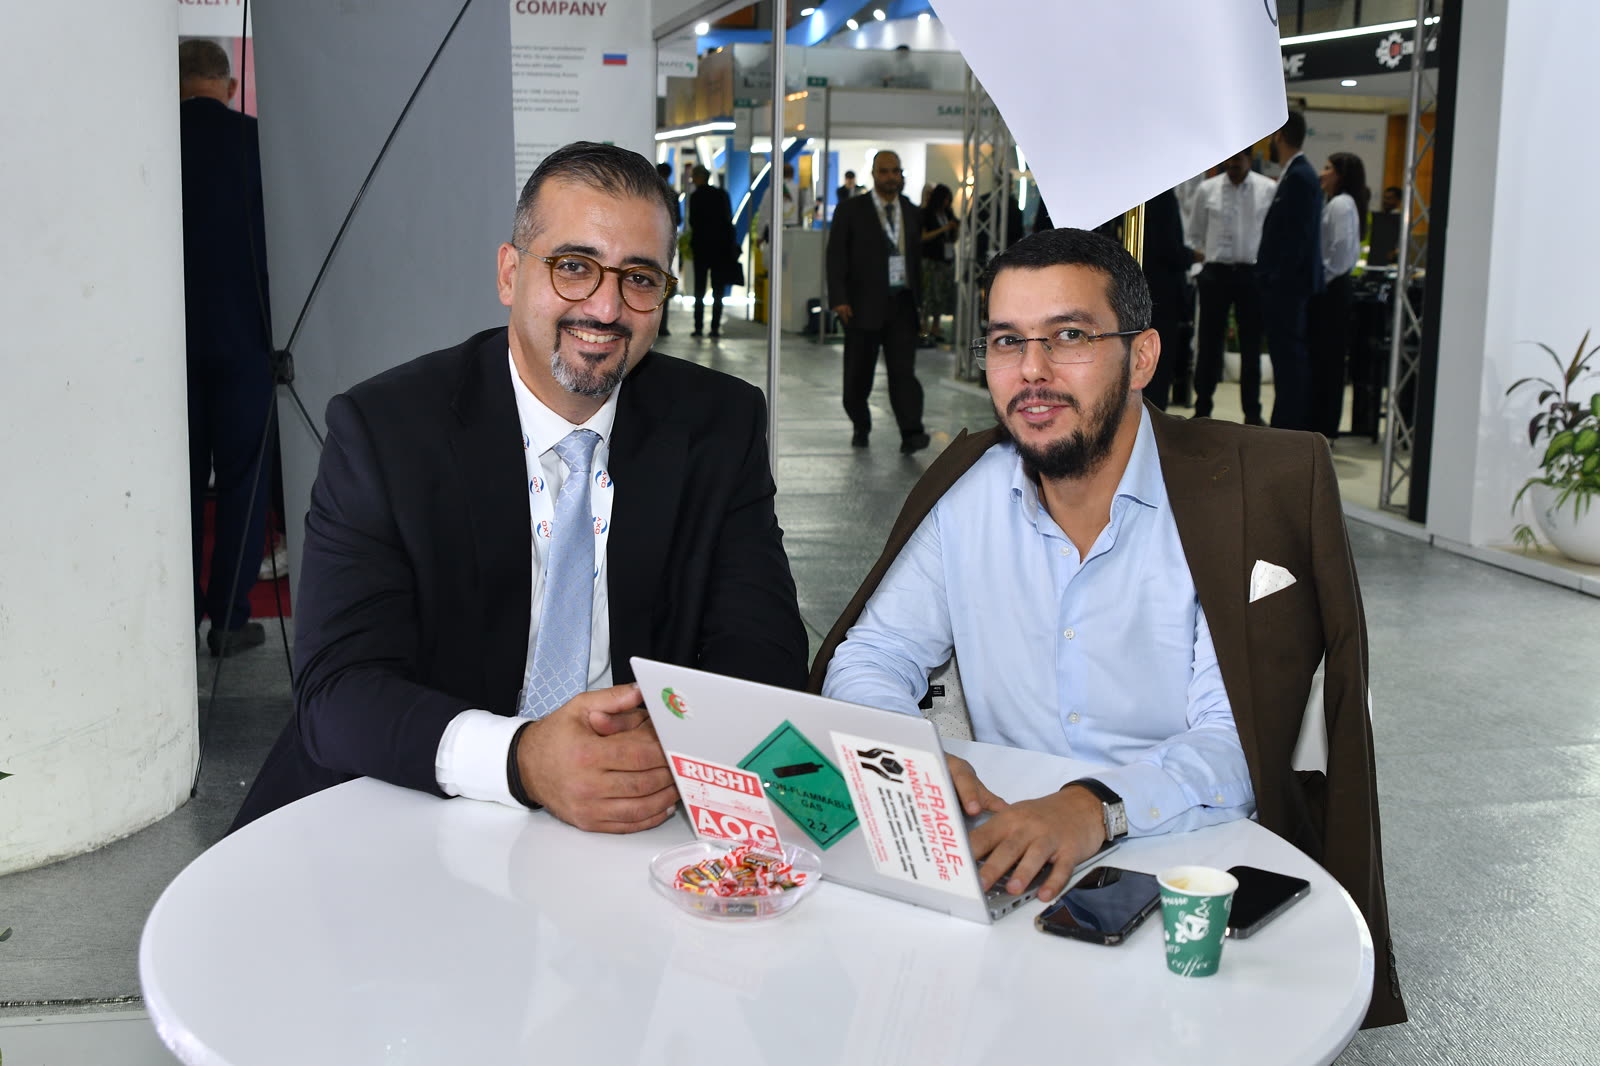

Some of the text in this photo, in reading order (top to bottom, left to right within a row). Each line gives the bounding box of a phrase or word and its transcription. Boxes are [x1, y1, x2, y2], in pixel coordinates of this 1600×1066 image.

[516, 0, 607, 16] COMPANY
[532, 476, 540, 493] OXY
[541, 520, 550, 538] OXY
[681, 760, 755, 794] RUSH!
[801, 800, 823, 812] GAS
[698, 808, 778, 849] AOG
[903, 758, 928, 811] HANDLE
[921, 809, 938, 845] WITH
[931, 846, 950, 881] CARE
